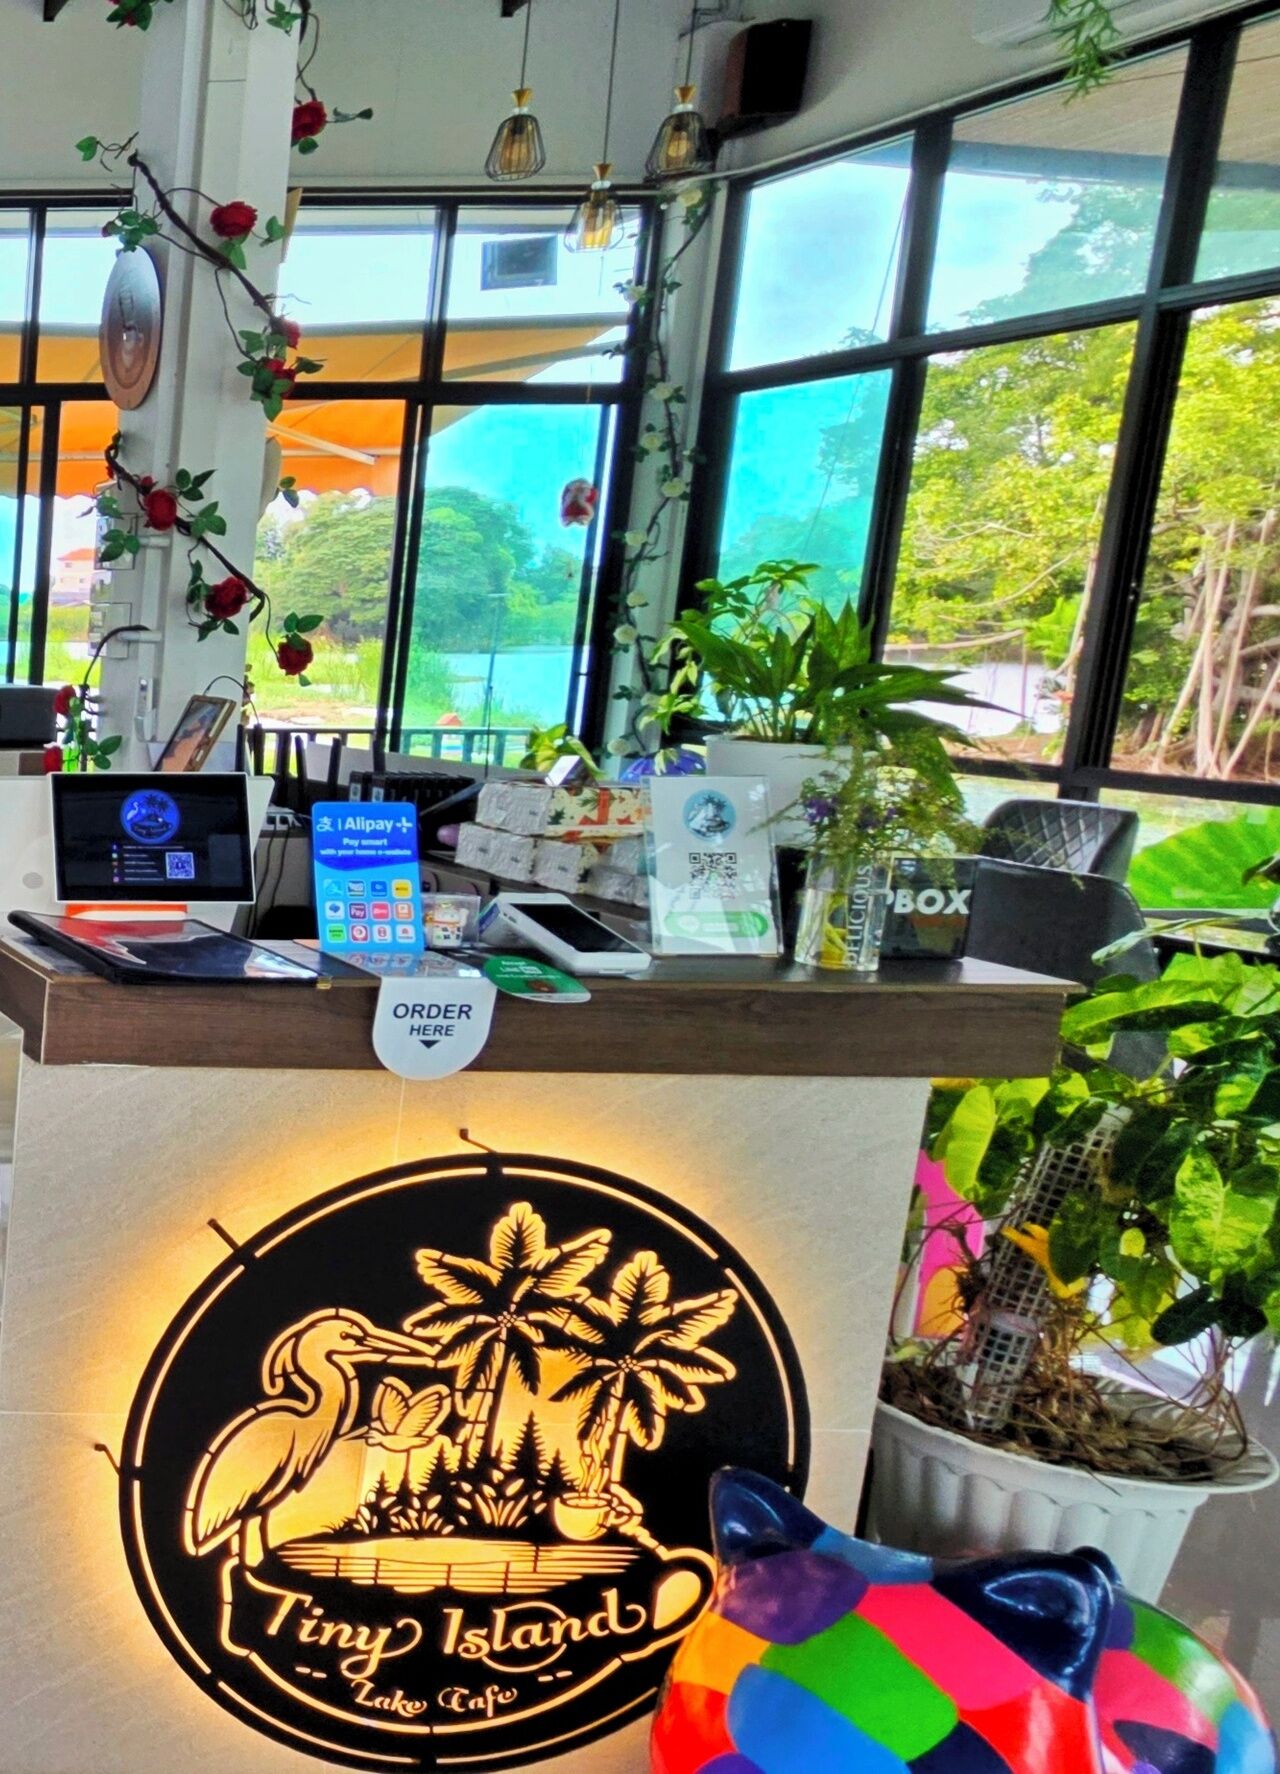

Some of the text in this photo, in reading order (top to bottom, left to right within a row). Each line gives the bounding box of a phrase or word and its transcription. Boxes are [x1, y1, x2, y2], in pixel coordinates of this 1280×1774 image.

[344, 816, 394, 833] Alipay
[343, 837, 388, 847] Pay smart
[845, 865, 873, 965] DELICIOUS
[392, 1003, 473, 1021] ORDER
[409, 1024, 456, 1037] HERE
[252, 1574, 647, 1679] Tiny Island
[350, 1679, 519, 1718] Lake Cafe
